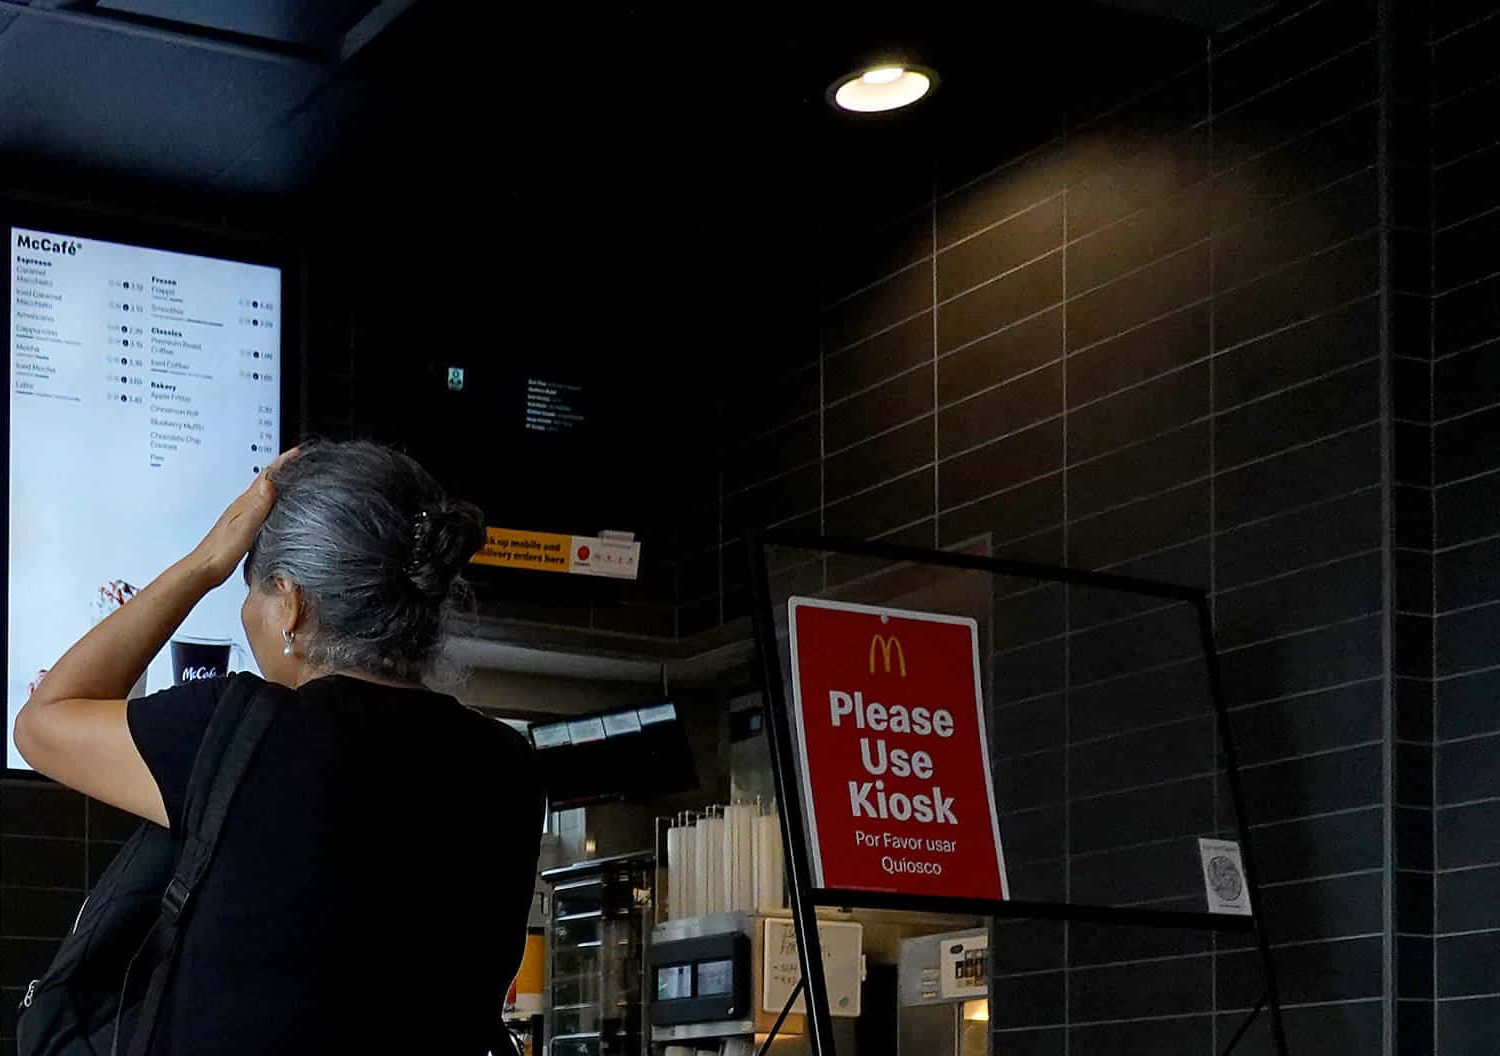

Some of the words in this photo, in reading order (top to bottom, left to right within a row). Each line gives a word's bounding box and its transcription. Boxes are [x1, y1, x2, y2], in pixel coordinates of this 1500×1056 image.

[151, 327, 183, 338] Classics
[150, 381, 177, 392] Bakery
[829, 690, 955, 738] Please
[859, 737, 934, 780] Use
[848, 779, 958, 825] Kiosk
[855, 831, 880, 848] Por
[883, 833, 923, 851] Favor
[926, 839, 956, 853] usar
[881, 855, 942, 876] Quiosco
